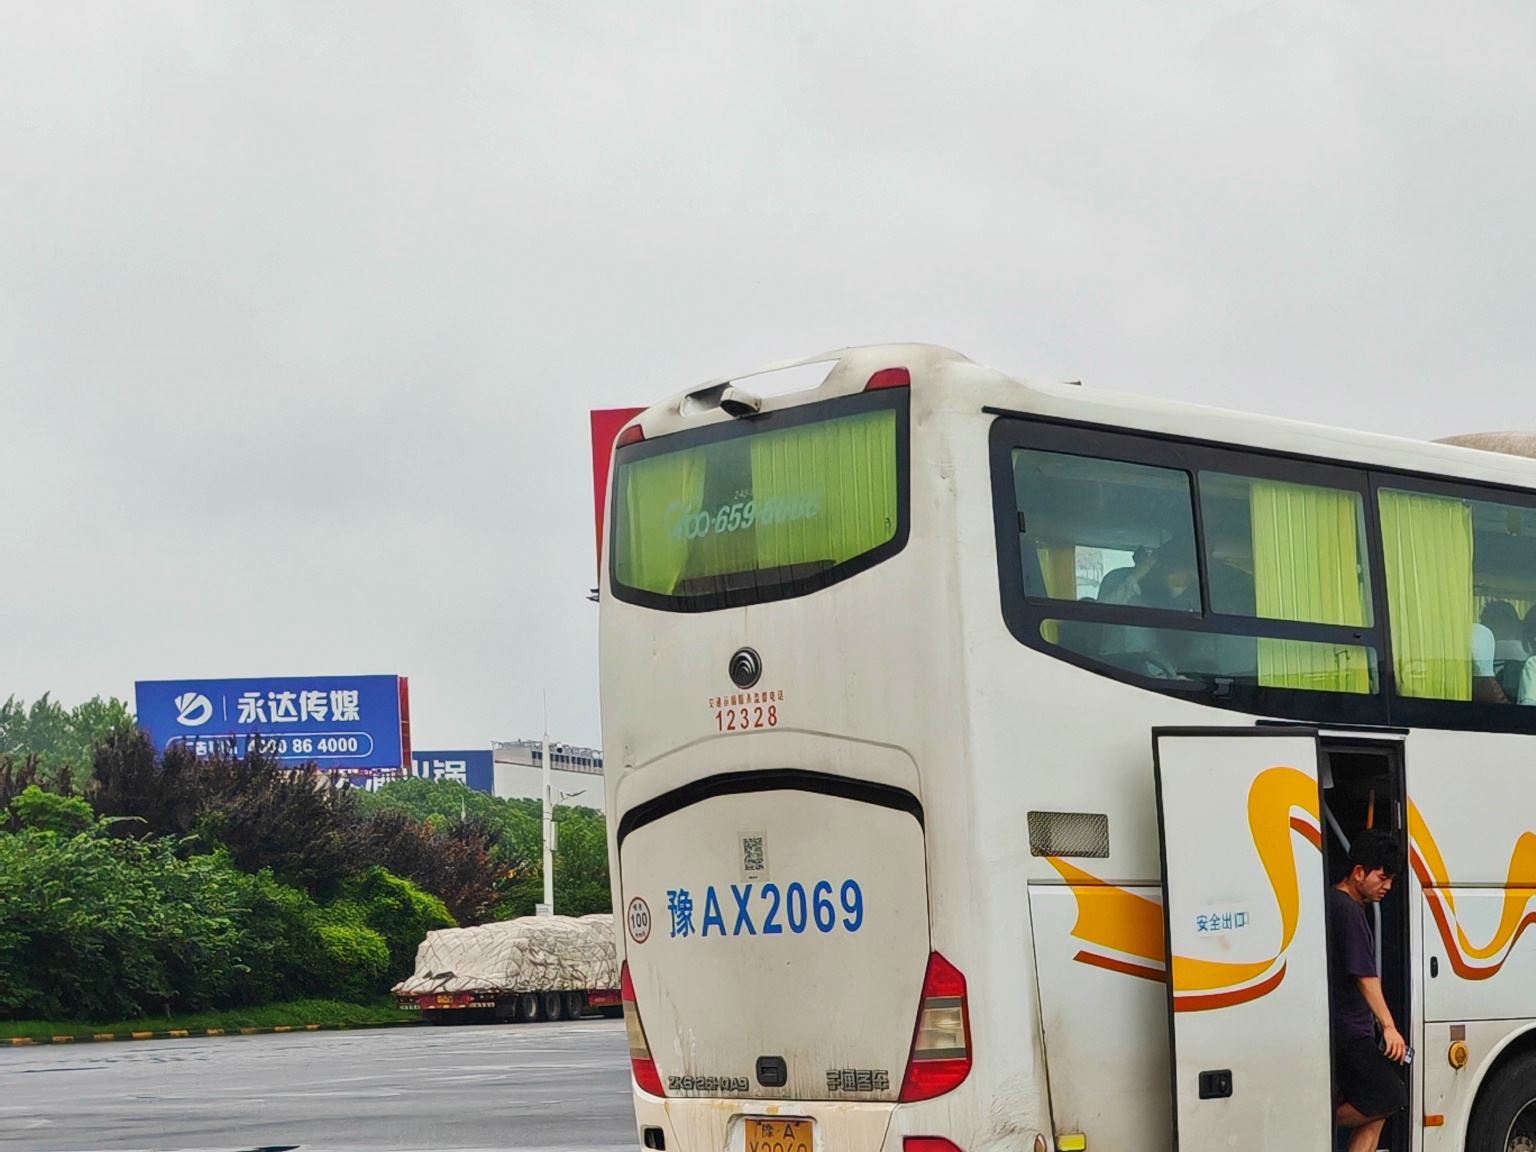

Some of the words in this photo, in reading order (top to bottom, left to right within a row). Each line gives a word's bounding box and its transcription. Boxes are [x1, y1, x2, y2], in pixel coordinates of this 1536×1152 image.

[237, 689, 361, 724] 永达传媒
[715, 705, 777, 732] 12328
[292, 738, 313, 754] 86
[317, 737, 359, 753] 4000
[631, 912, 648, 929] 100
[666, 878, 864, 939] 豫AX2069
[1196, 911, 1247, 932] 安全出口
